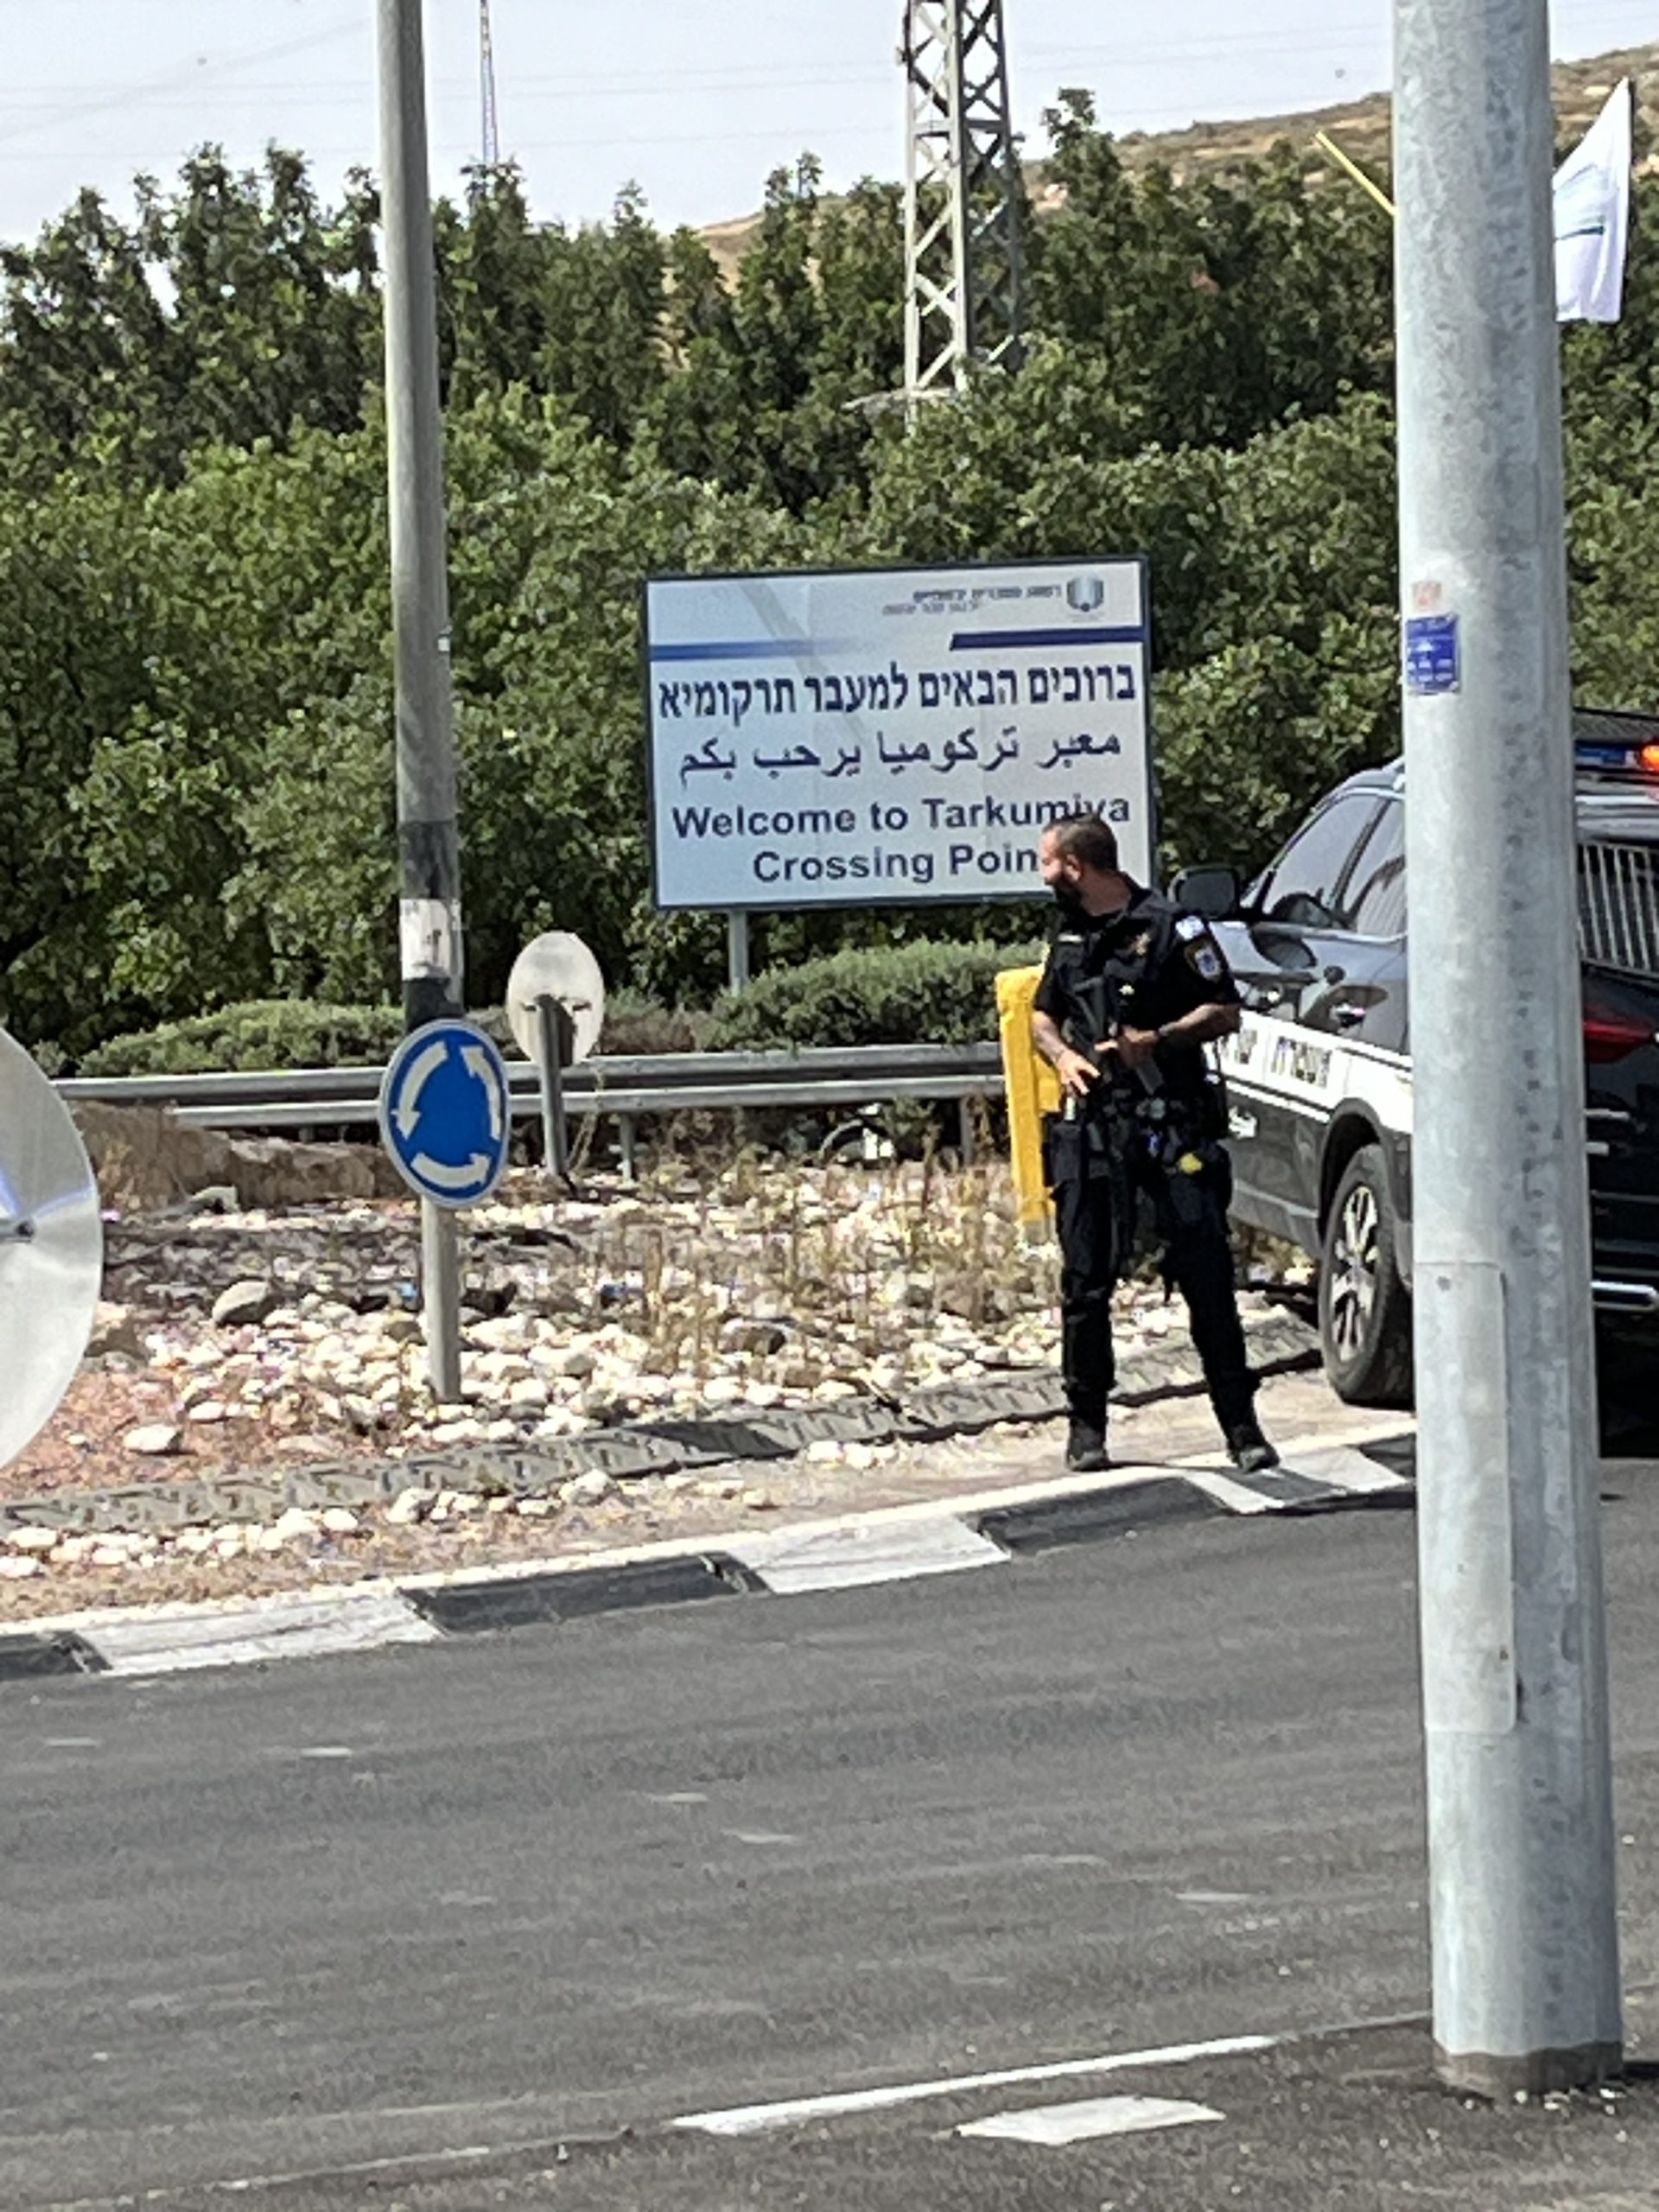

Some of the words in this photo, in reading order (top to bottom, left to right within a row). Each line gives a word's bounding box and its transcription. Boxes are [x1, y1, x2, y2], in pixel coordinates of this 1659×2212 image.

[658, 677, 796, 727] תרקומיא
[804, 661, 908, 713] למעבר
[918, 669, 1018, 708] הבאים
[1027, 664, 1135, 703] ברוכים
[679, 737, 737, 790] بكم
[753, 745, 861, 779] يرحب
[876, 726, 1019, 775] تركوميا
[1034, 734, 1121, 770] معبر
[671, 802, 856, 838] Welcome
[870, 801, 909, 831] to
[753, 843, 934, 884] Crossing
[949, 842, 1039, 875] Poin
